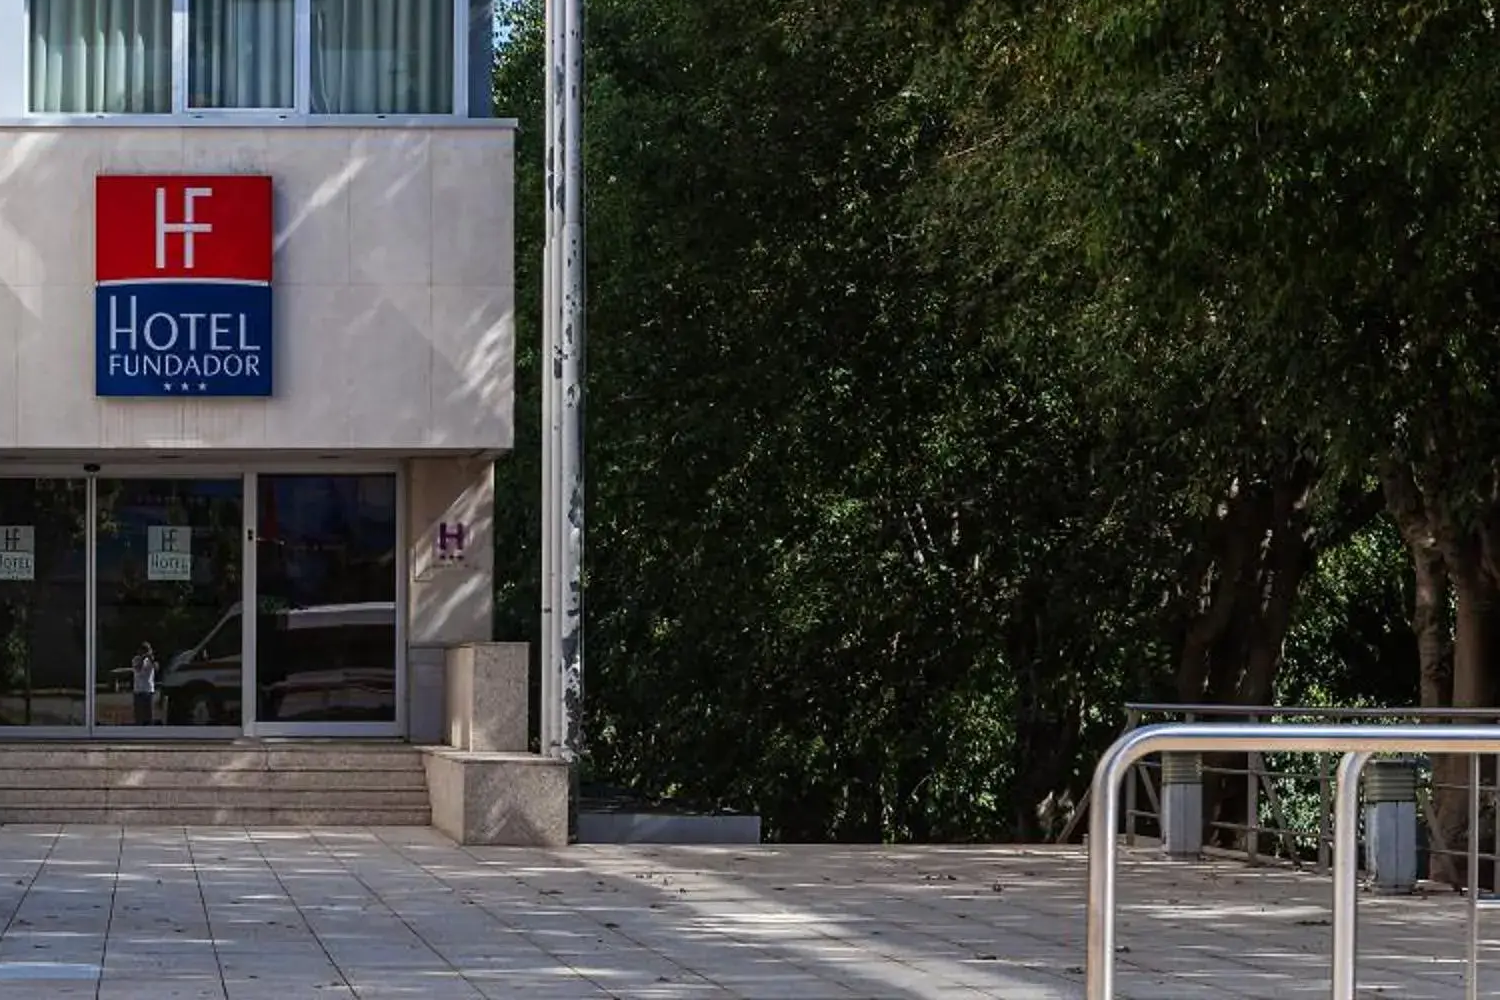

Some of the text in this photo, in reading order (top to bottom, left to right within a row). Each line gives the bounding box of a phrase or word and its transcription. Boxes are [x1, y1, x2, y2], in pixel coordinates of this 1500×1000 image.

[155, 187, 213, 269] HF
[109, 295, 261, 351] HOTEL
[108, 353, 261, 377] FUNDADOR
[440, 522, 464, 550] H
